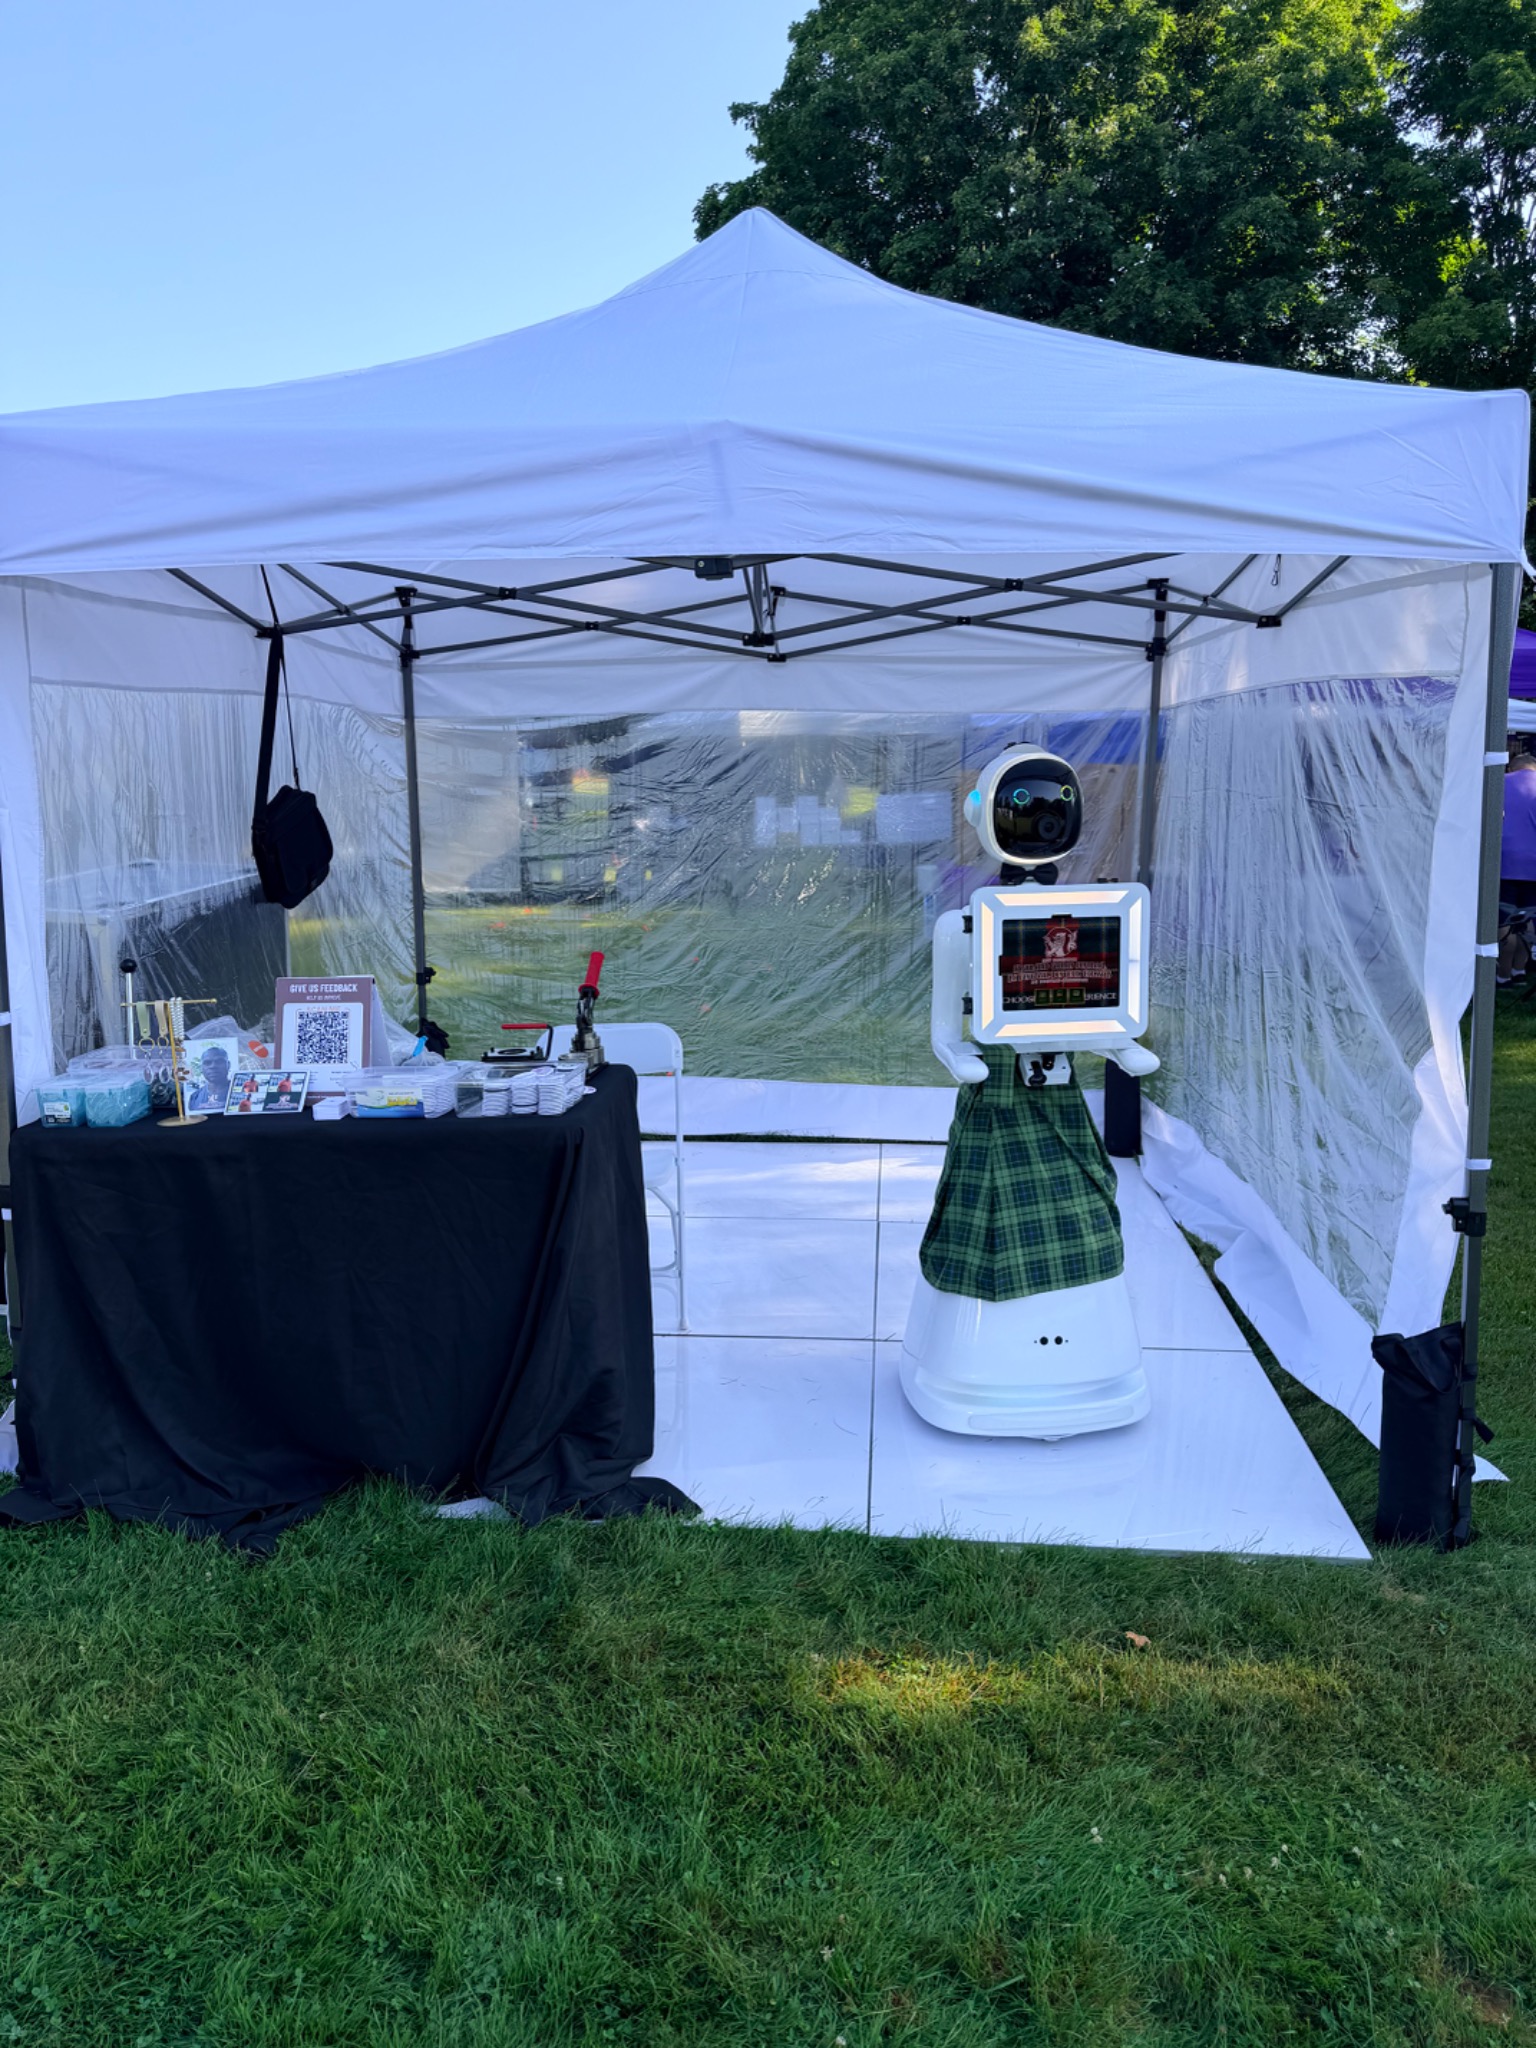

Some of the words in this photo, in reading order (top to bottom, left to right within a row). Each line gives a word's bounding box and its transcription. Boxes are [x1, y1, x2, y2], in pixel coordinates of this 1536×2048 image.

[290, 984, 307, 993] GIVE
[308, 984, 319, 992] US
[320, 983, 358, 992] FEEDBACK
